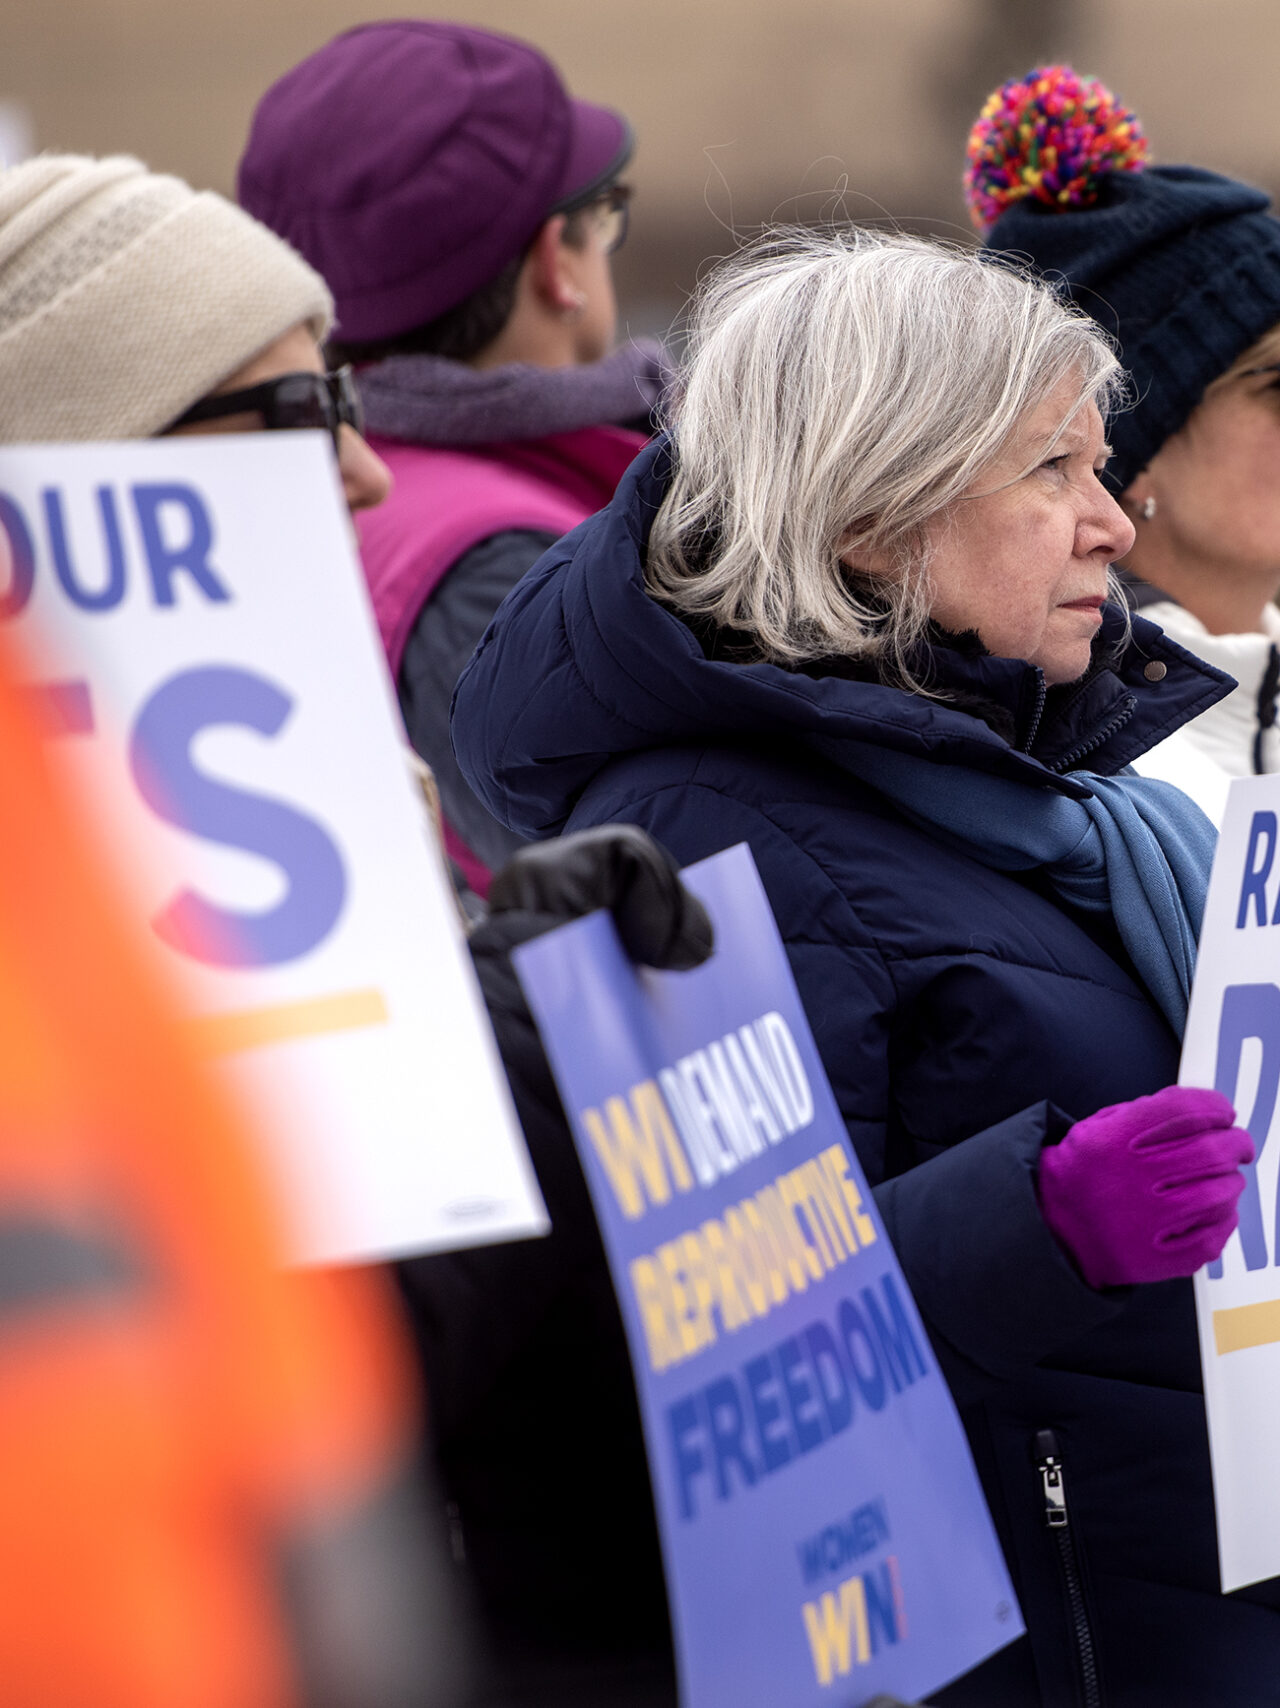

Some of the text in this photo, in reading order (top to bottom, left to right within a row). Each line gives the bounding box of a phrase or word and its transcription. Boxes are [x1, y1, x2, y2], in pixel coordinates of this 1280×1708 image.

[630, 1143, 877, 1376] REPRODUCTIVE
[667, 1271, 930, 1524] FREEDOM
[798, 1499, 891, 1584] WOMEN
[802, 1560, 898, 1687] WIN
